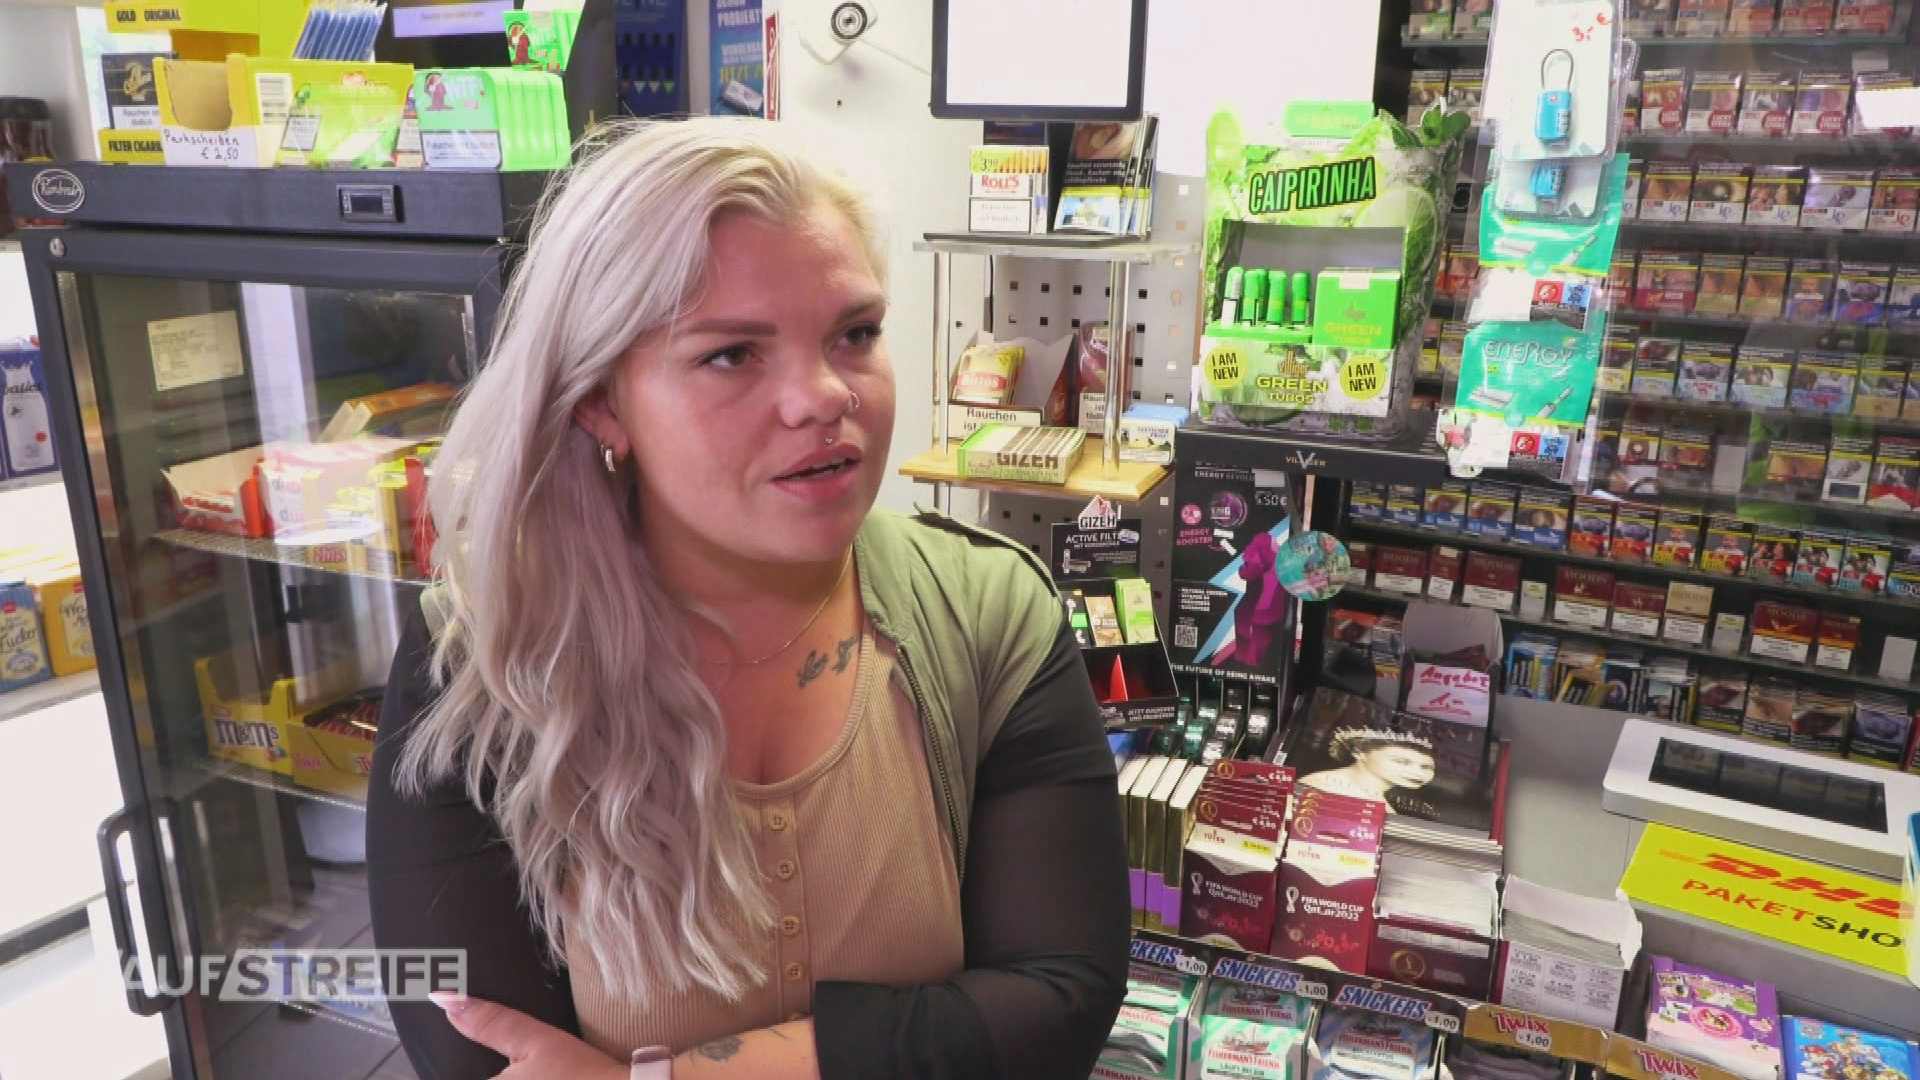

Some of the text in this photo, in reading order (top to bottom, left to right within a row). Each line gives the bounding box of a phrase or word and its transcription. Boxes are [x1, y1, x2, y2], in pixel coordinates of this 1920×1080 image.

[116, 8, 181, 22] GOLD ORIGINAL
[164, 128, 239, 146] Parkscheiben
[108, 141, 132, 152] FILTER
[215, 148, 239, 162] 2,50
[1249, 157, 1376, 215] CAIPIRINHA
[1324, 322, 1382, 336] GREEN
[1219, 352, 1237, 366] AM
[1213, 366, 1239, 381] NEW
[1355, 363, 1375, 377] AM
[1257, 376, 1329, 393] GREEN
[1349, 376, 1377, 392] NEW
[967, 407, 1017, 421] Rauchen
[996, 452, 1059, 470] GIZEH
[1194, 470, 1225, 480] ENERGY
[1080, 516, 1116, 528] GIZEH
[1065, 532, 1098, 544] ACTIVE
[1170, 662, 1276, 683] THE FUTURE OF BEING AWAKE
[1205, 879, 1221, 890] FIFA
[1222, 884, 1248, 898] WORLD
[1301, 895, 1365, 914] FIFA WORLD CUP
[1213, 957, 1304, 993] SNICKERS
[1336, 984, 1431, 1020] SNICKERS
[1490, 1011, 1549, 1034] Twix
[1208, 1049, 1281, 1069] FISHERMAN'S FRIEND
[1636, 1049, 1698, 1079] Twix
